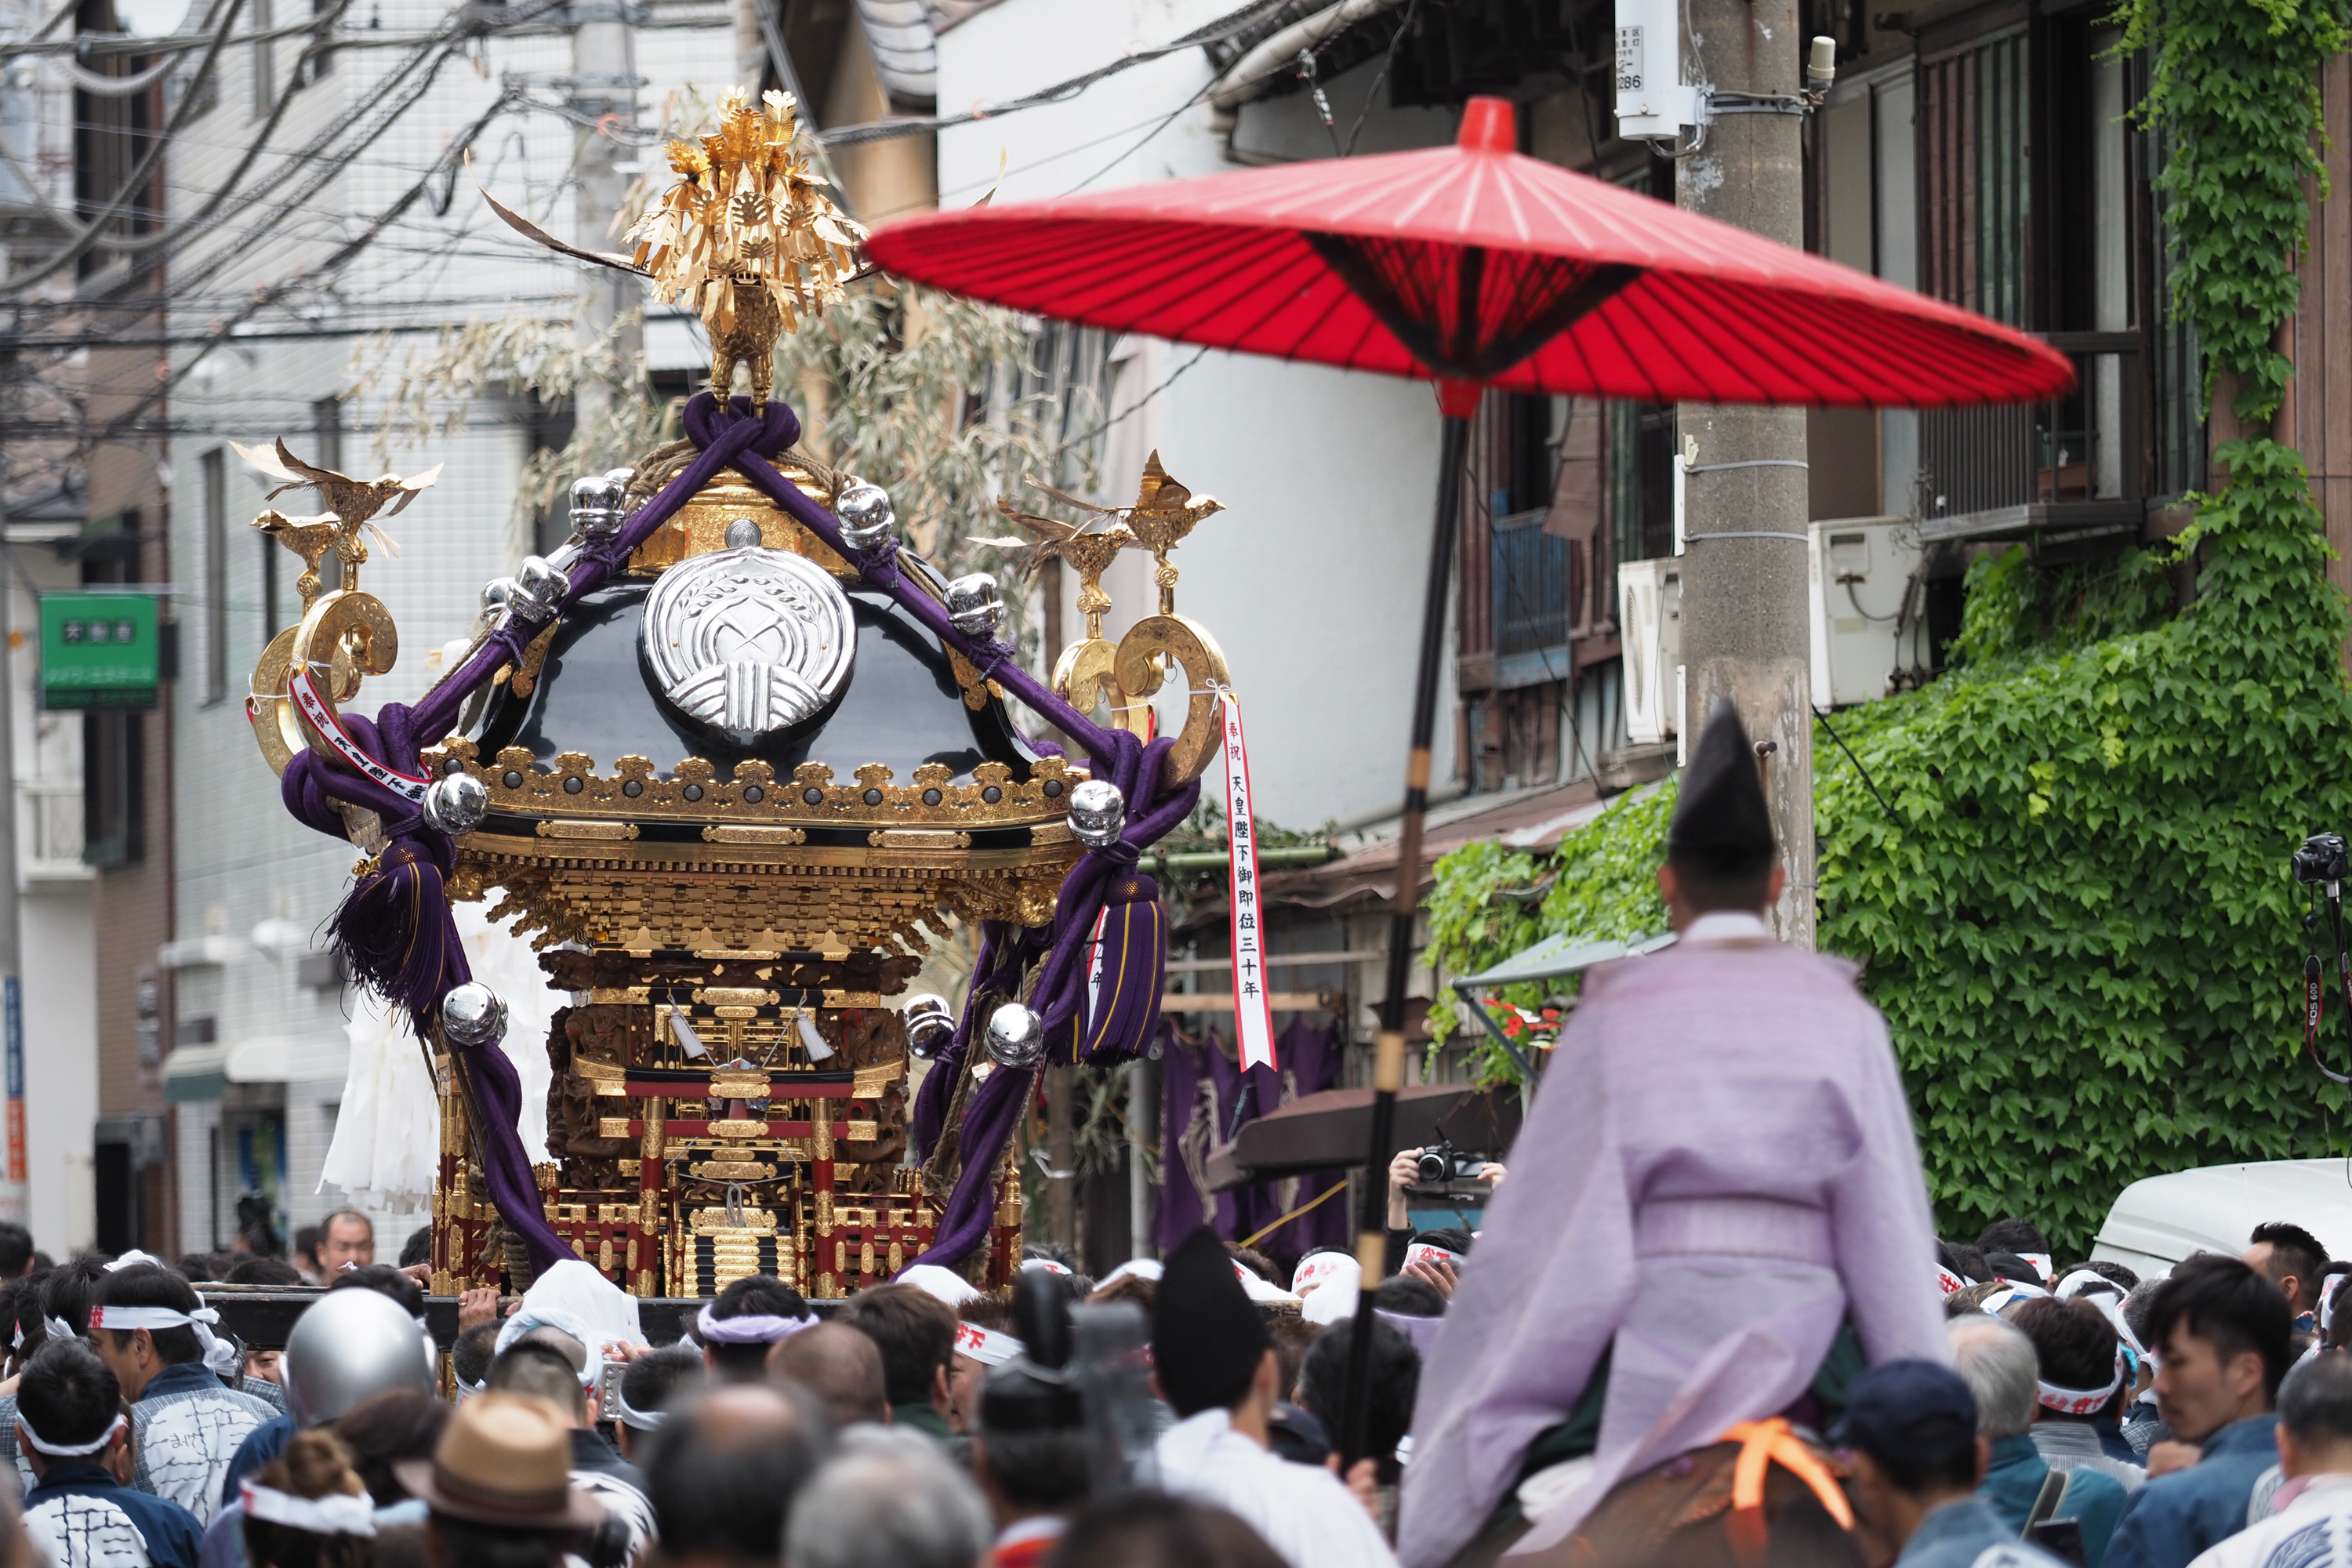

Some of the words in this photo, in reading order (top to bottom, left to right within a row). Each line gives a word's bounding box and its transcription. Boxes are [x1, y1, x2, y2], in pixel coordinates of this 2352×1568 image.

[302, 691, 329, 728] 奉祝
[1229, 721, 1241, 761] 奉祝
[1232, 775, 1260, 1000] 天皇陛下御即位三十年
[2310, 982, 2318, 1000] 60D
[2309, 1002, 2318, 1026] EOS
